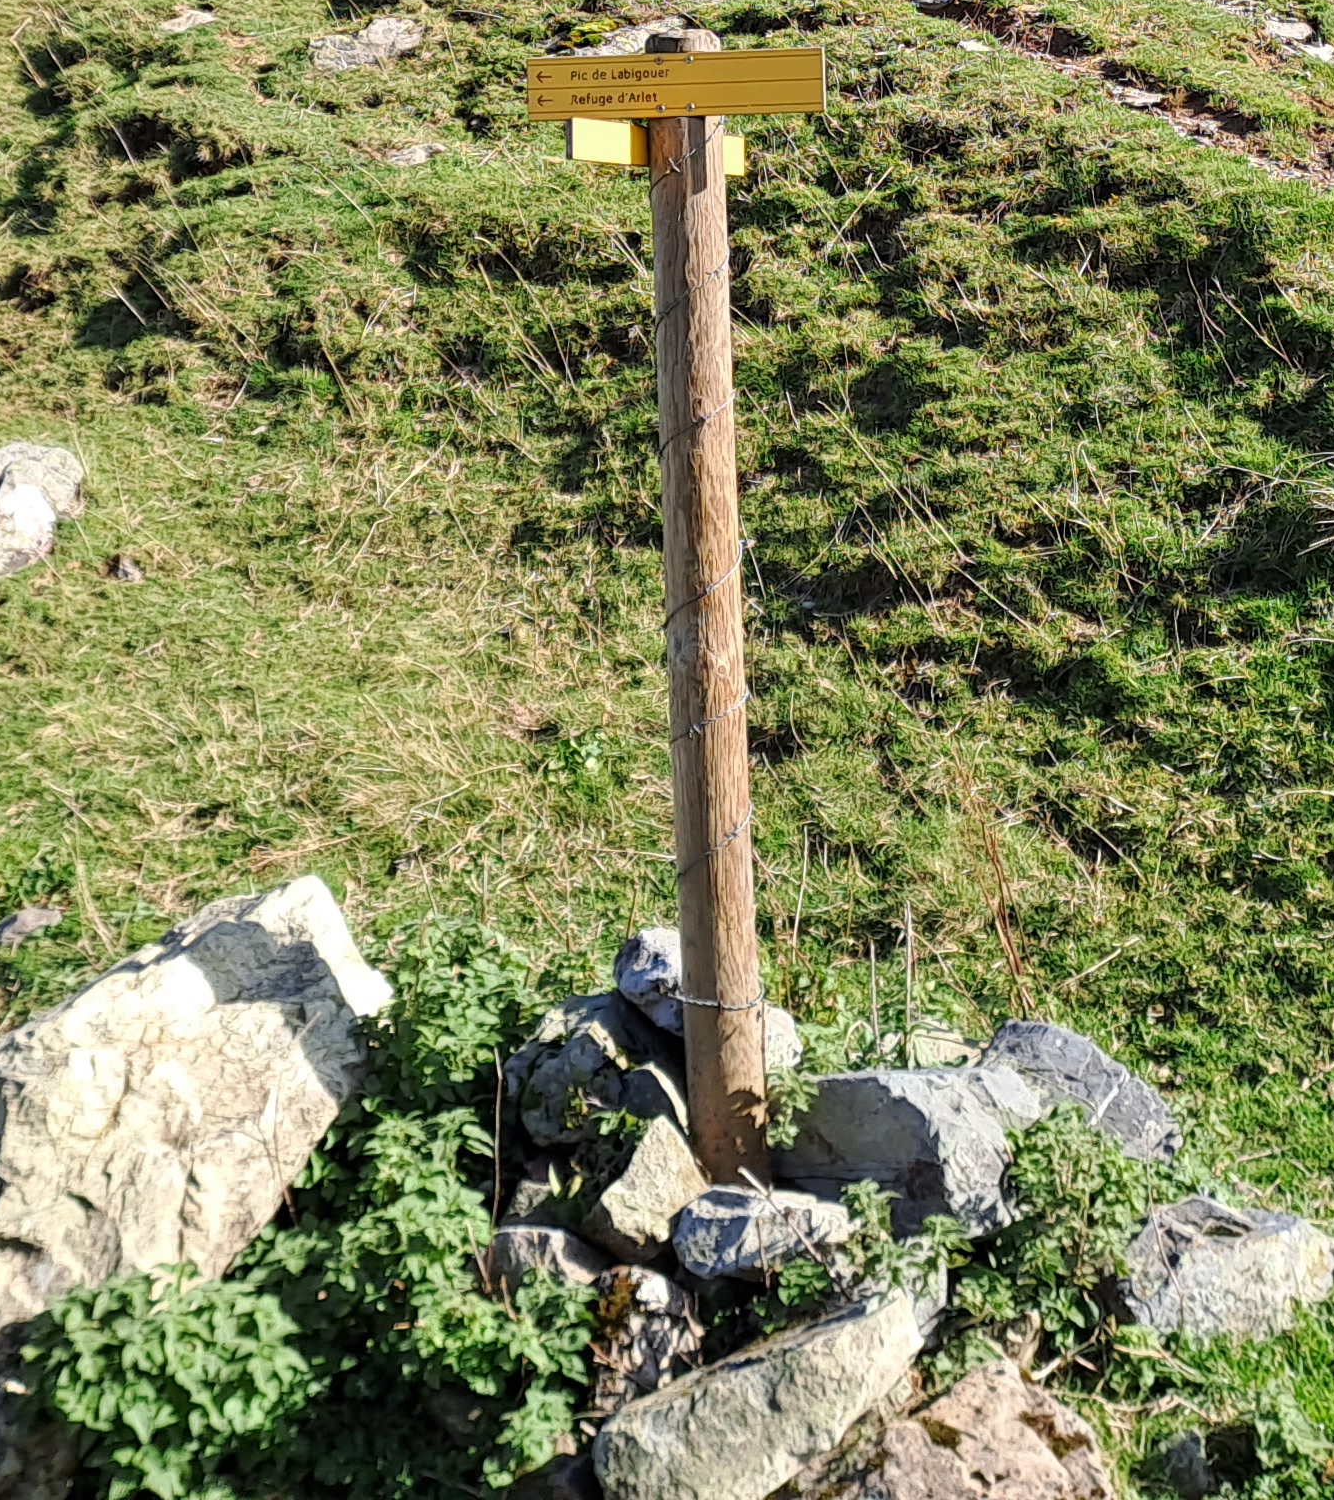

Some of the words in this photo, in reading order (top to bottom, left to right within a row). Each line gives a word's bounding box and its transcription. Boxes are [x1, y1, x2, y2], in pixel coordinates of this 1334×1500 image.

[570, 70, 588, 81] Pic
[592, 69, 607, 80] de
[611, 68, 670, 81] Labigouer
[570, 93, 613, 106] Refuge
[617, 91, 658, 103] d'Arlet
